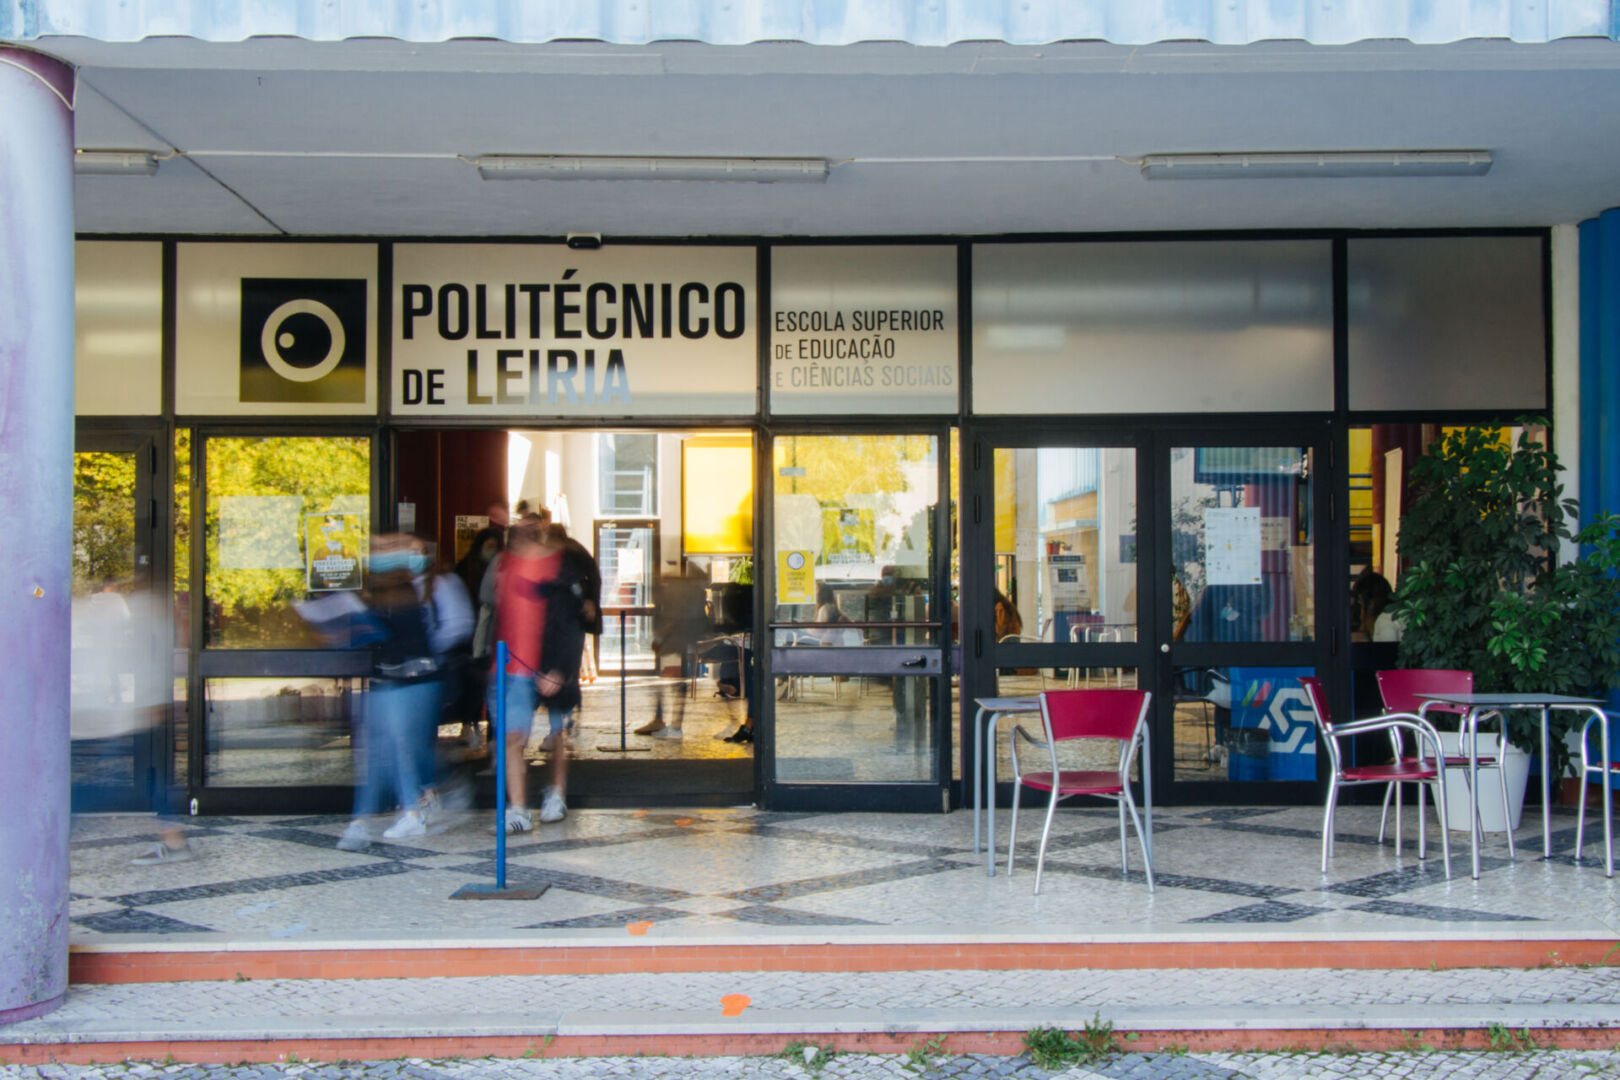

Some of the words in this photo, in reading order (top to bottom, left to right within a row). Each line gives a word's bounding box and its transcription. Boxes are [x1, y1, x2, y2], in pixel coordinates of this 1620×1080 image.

[402, 268, 745, 341] POLITÉCNICO
[775, 310, 845, 332] ESCOLA
[852, 309, 944, 332] SUPERIOR
[775, 344, 792, 360] DE
[799, 334, 895, 364] EDUCAÇÃO
[402, 369, 446, 405] DE
[467, 348, 633, 405] LEIRIA
[775, 371, 784, 387] E
[790, 361, 874, 387] CIÊNCIAS
[881, 365, 953, 387] SOCIAIS
